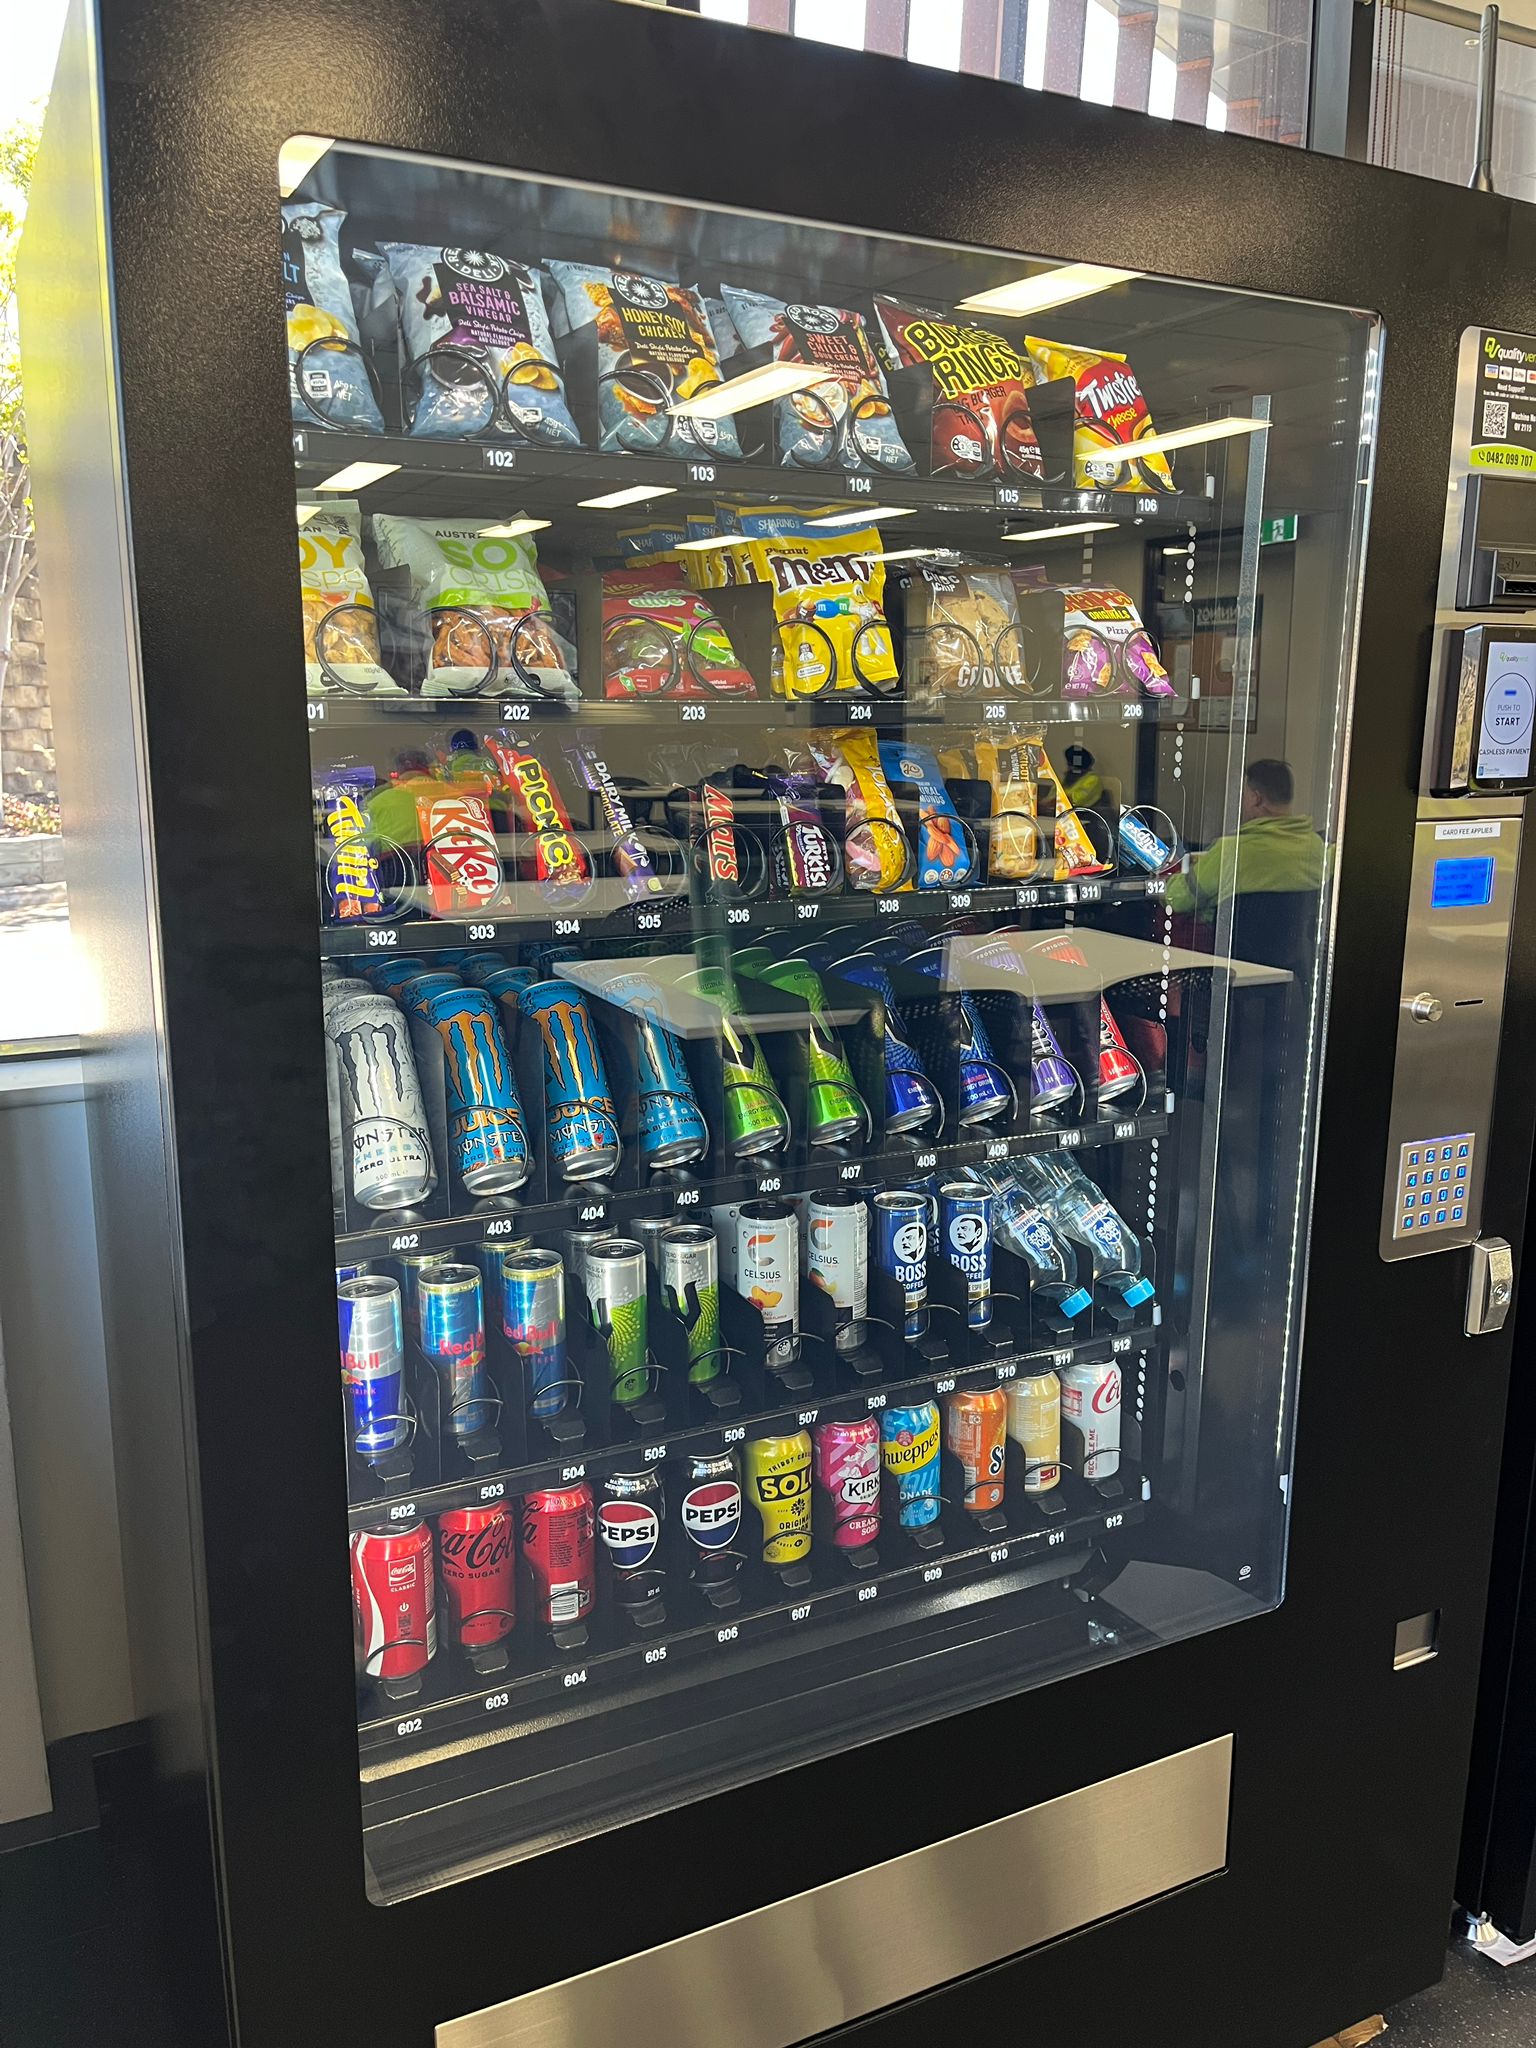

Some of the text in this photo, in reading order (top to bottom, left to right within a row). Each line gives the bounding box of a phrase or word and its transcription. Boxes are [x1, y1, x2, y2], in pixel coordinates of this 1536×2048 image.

[460, 265, 496, 279] DELI
[456, 282, 477, 293] SEA
[478, 285, 502, 298] SALT
[448, 291, 521, 316] BALSAMIC
[465, 305, 513, 324] VINEGAR
[621, 307, 687, 335] HONEY SOY
[806, 334, 848, 346] SWEET
[807, 342, 858, 354] CHILLI &
[814, 352, 861, 363] SOUR CREAM
[932, 342, 1023, 400] RINGS
[1106, 407, 1138, 430] Cheese
[1511, 411, 1530, 422] Machine
[486, 450, 513, 468] 102
[1486, 451, 1534, 467] 0482 099 707
[690, 466, 715, 482] 103
[849, 478, 872, 493] 104
[999, 489, 1019, 503] 105
[1138, 498, 1158, 513] 106
[299, 535, 354, 569] OY
[438, 538, 518, 572] SO
[450, 568, 543, 591] CRISP
[922, 569, 961, 586] CHOC
[931, 582, 957, 594] CHIP
[1088, 609, 1132, 621] ORIGINALS
[1106, 626, 1130, 635] Pizza
[503, 704, 531, 721] 202
[682, 706, 706, 721] 203
[851, 705, 872, 720] 204
[985, 705, 1006, 718] 205
[1123, 704, 1143, 717] 206
[1497, 704, 1521, 712] PUSH TO
[1495, 717, 1521, 727] START
[1479, 748, 1506, 756] CASHLESS
[593, 761, 641, 846] DAIRY MILK
[515, 758, 574, 869] PICNIC
[597, 785, 624, 838] CHOCOLATE
[1442, 828, 1458, 836] CARD
[1470, 826, 1493, 835] APPLIES
[326, 795, 380, 899] Twirl
[1125, 822, 1165, 859] eclipse
[431, 804, 500, 896] KitKat
[1081, 885, 1099, 899] 311
[1147, 880, 1165, 894] 312
[951, 894, 971, 908] 309
[1018, 889, 1038, 904] 310
[797, 905, 819, 919] 307
[879, 900, 900, 914] 308
[637, 915, 662, 930] 305
[727, 909, 750, 924] 306
[469, 925, 496, 941] 303
[555, 920, 581, 935] 304
[368, 930, 398, 947] 302
[923, 963, 938, 974] BLUE
[550, 1098, 616, 1124] JUICE
[452, 1108, 521, 1139] JUICE
[1116, 1124, 1133, 1137] 411
[1061, 1132, 1079, 1146] 410
[988, 1143, 1008, 1157] 409
[359, 1154, 422, 1174] ZERO ULTRA
[917, 1154, 936, 1168] 408
[841, 1165, 861, 1180] 407
[759, 1178, 781, 1192] 406
[676, 1191, 699, 1206] 405
[580, 1206, 605, 1221] 404
[486, 1220, 512, 1235] 403
[391, 1234, 419, 1250] 402
[1031, 1234, 1052, 1249] COOL
[808, 1250, 839, 1265] CELSIUS
[950, 1253, 987, 1273] BOSS
[744, 1268, 781, 1280] CELSIUS
[894, 1260, 927, 1283] BOSS
[525, 1320, 559, 1340] Bull
[439, 1338, 474, 1356] Red
[1113, 1339, 1131, 1352] 512
[346, 1353, 381, 1372] Bull
[1054, 1352, 1072, 1365] 511
[997, 1365, 1016, 1379] 510
[936, 1380, 956, 1393] 509
[867, 1395, 887, 1408] 508
[798, 1410, 819, 1425] 507
[724, 1427, 746, 1442] 506
[1088, 1428, 1096, 1441] ME
[883, 1424, 939, 1466] hweppes
[644, 1446, 667, 1461] 505
[561, 1465, 586, 1480] 504
[768, 1457, 795, 1474] THIRST
[761, 1465, 812, 1499] SOL
[480, 1483, 504, 1499] 503
[390, 1504, 416, 1520] 502
[685, 1501, 740, 1523] PEPSI
[1106, 1514, 1123, 1528] 612
[600, 1524, 656, 1542] PEPSI
[1048, 1532, 1065, 1546] 611
[990, 1549, 1009, 1563] 610
[443, 1568, 501, 1580] ZERO SUGAR
[923, 1567, 943, 1582] 609
[390, 1582, 416, 1593] CLASSIC
[858, 1587, 878, 1601] 608
[791, 1606, 811, 1620] 607
[717, 1627, 738, 1642] 606
[645, 1647, 667, 1662] 605
[564, 1670, 587, 1687] 604
[485, 1693, 509, 1710] 603
[397, 1718, 422, 1735] 602
